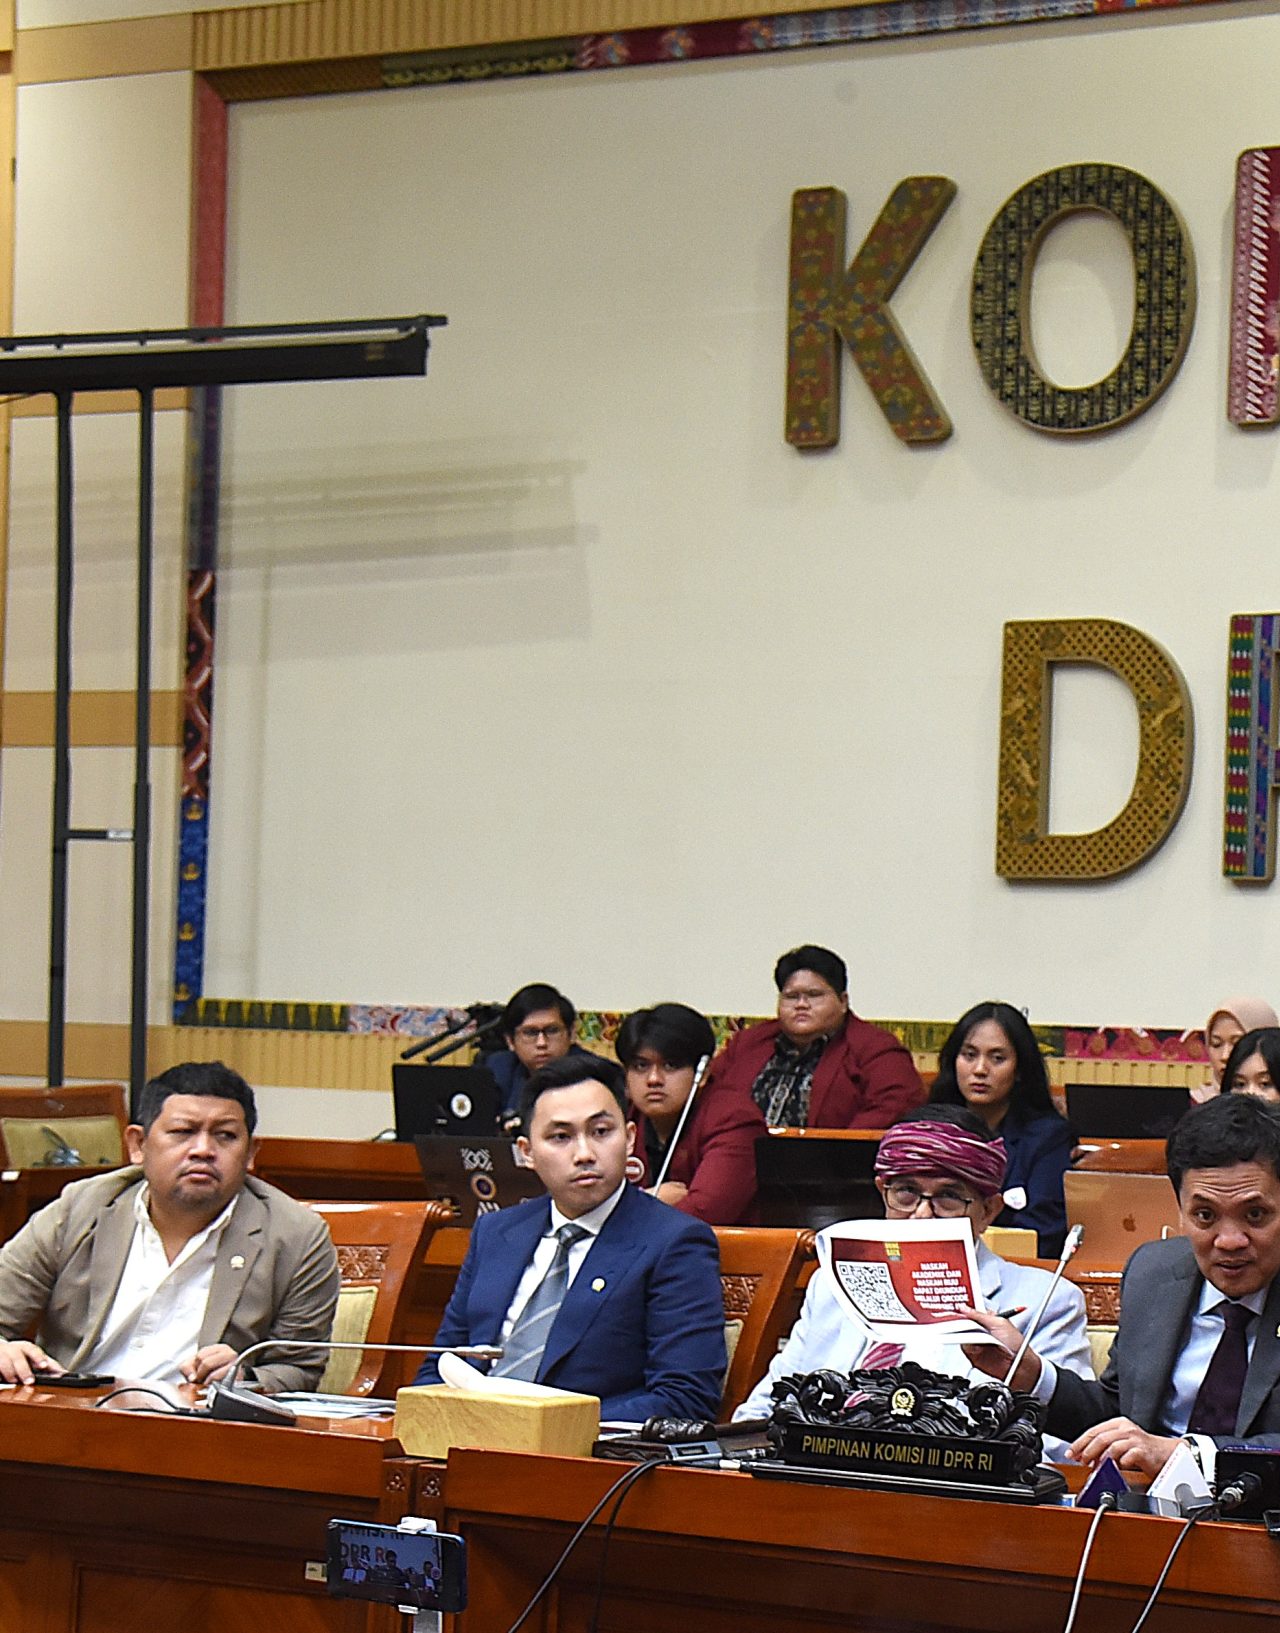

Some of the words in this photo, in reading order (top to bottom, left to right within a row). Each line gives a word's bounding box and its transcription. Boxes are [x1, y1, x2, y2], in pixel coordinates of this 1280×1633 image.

[802, 1435, 870, 1459] PIMPINAN
[873, 1443, 925, 1465] KOMISI
[927, 1448, 940, 1466] III
[943, 1450, 974, 1469] DPR
[978, 1453, 993, 1471] RI
